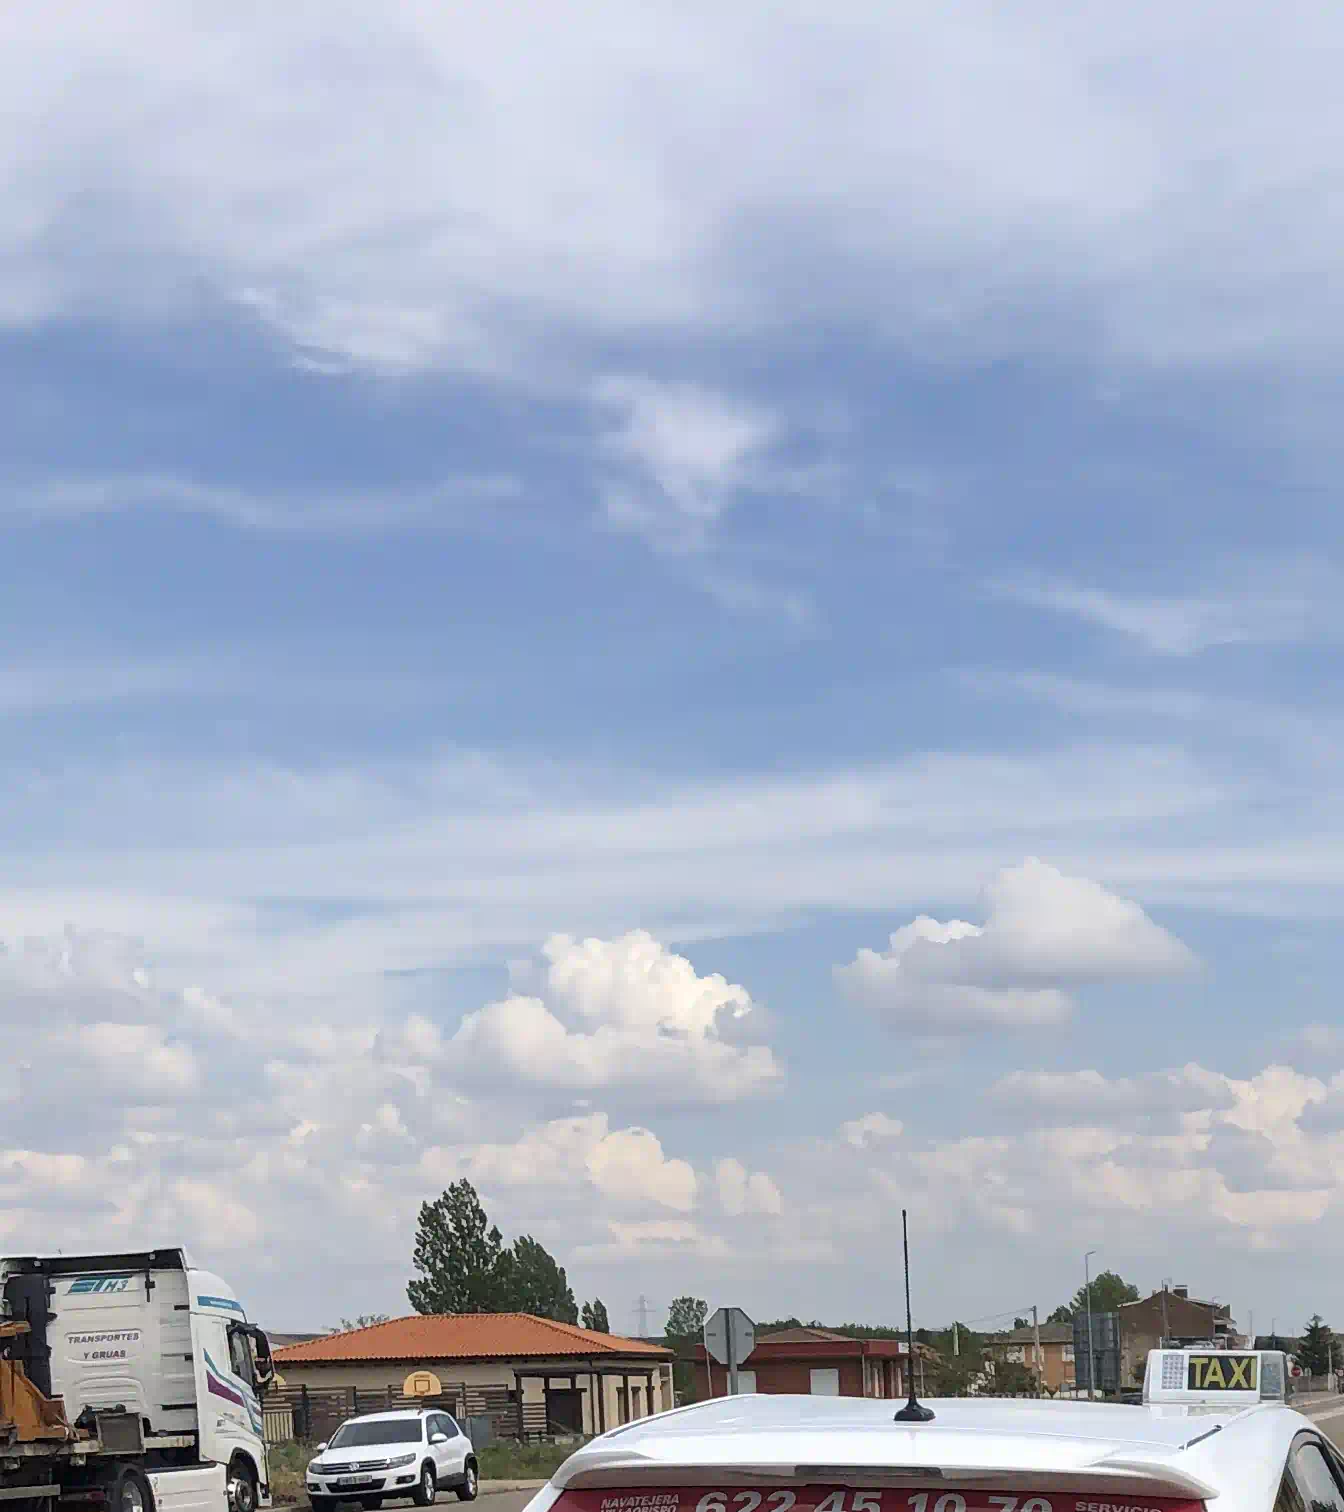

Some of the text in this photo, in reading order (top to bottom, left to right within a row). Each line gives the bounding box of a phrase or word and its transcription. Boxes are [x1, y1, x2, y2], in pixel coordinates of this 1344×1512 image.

[68, 1333, 139, 1344] TRANSPORTES
[83, 1350, 127, 1360] Y GRUAS
[1189, 1357, 1257, 1389] TAXI
[602, 1493, 679, 1509] NAVATEJERA
